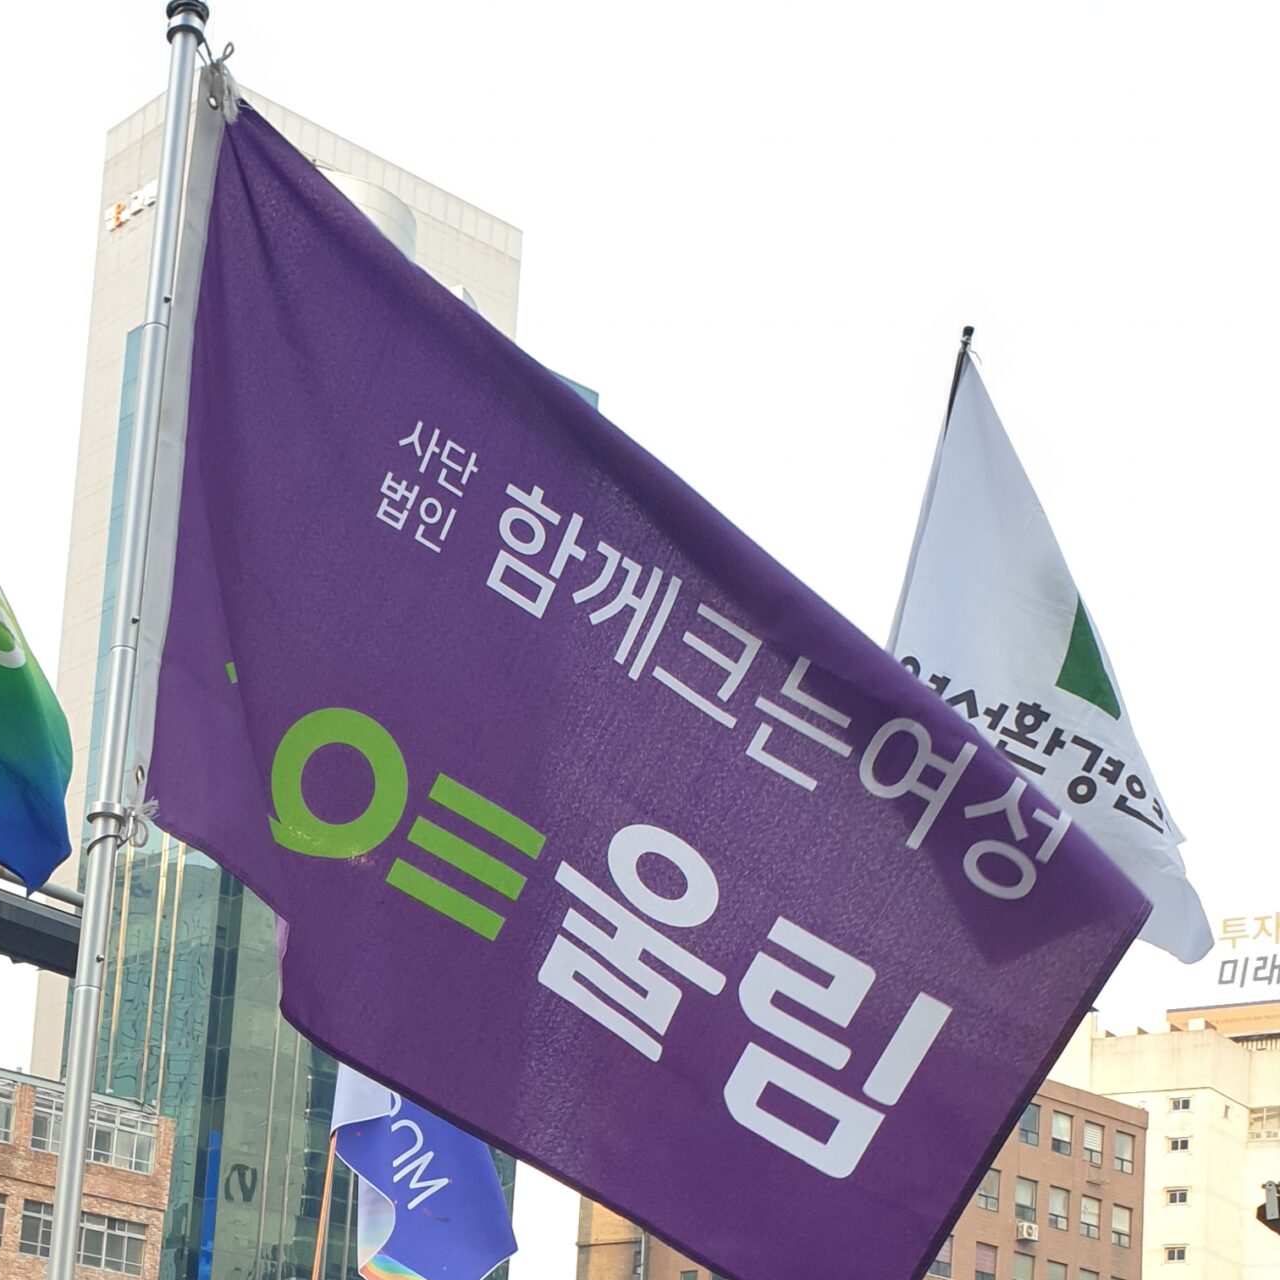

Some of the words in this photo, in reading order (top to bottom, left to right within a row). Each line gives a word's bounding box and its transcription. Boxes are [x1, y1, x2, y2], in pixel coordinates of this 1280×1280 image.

[398, 420, 478, 497] 사단
[375, 471, 459, 553] 법인
[537, 824, 953, 1178] 울림
